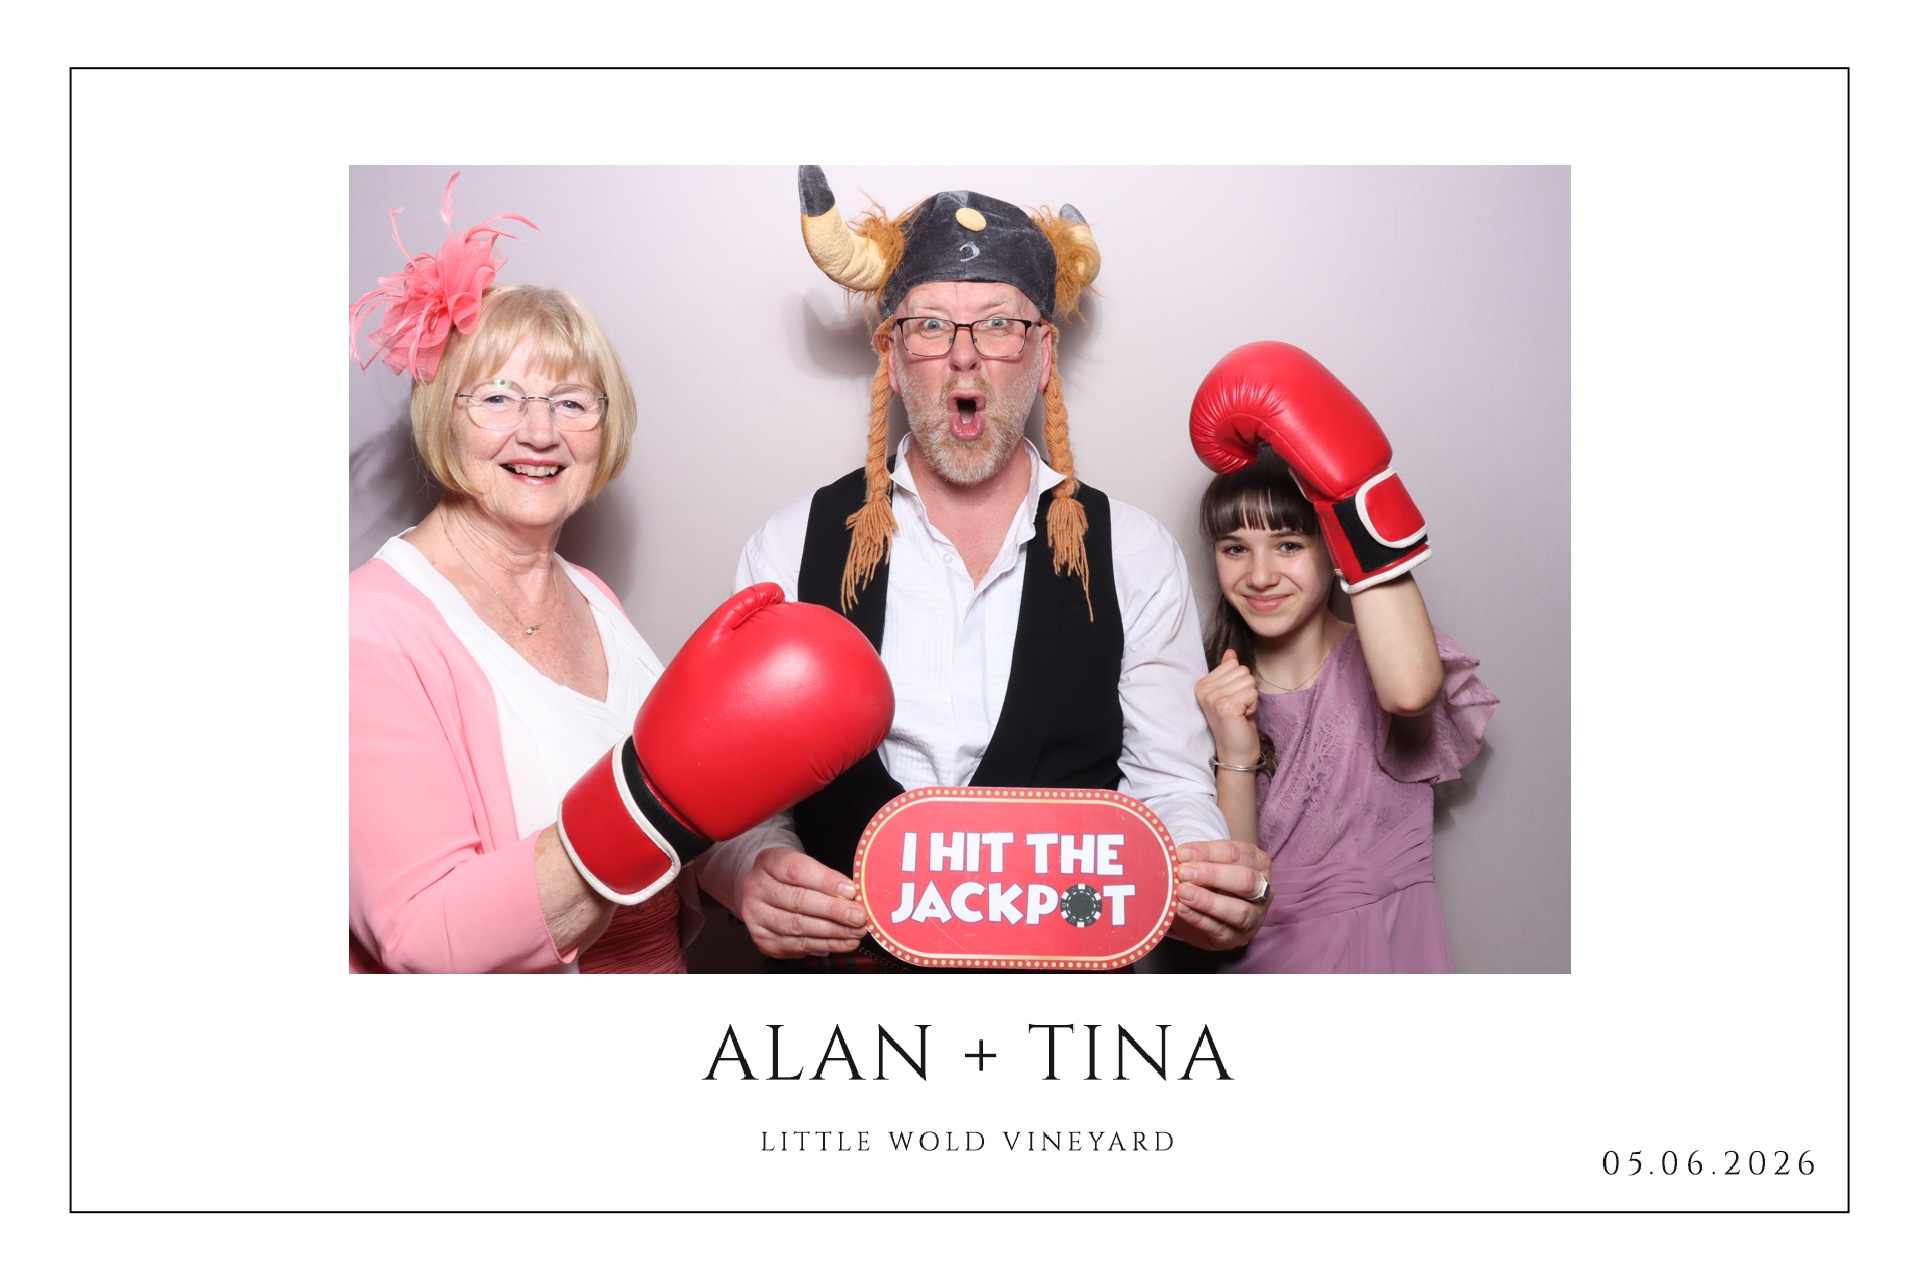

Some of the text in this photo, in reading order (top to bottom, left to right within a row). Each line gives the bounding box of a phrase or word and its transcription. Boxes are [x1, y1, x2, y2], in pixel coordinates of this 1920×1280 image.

[901, 831, 1125, 876] I HIT THE
[890, 879, 1136, 928] JACKPOT
